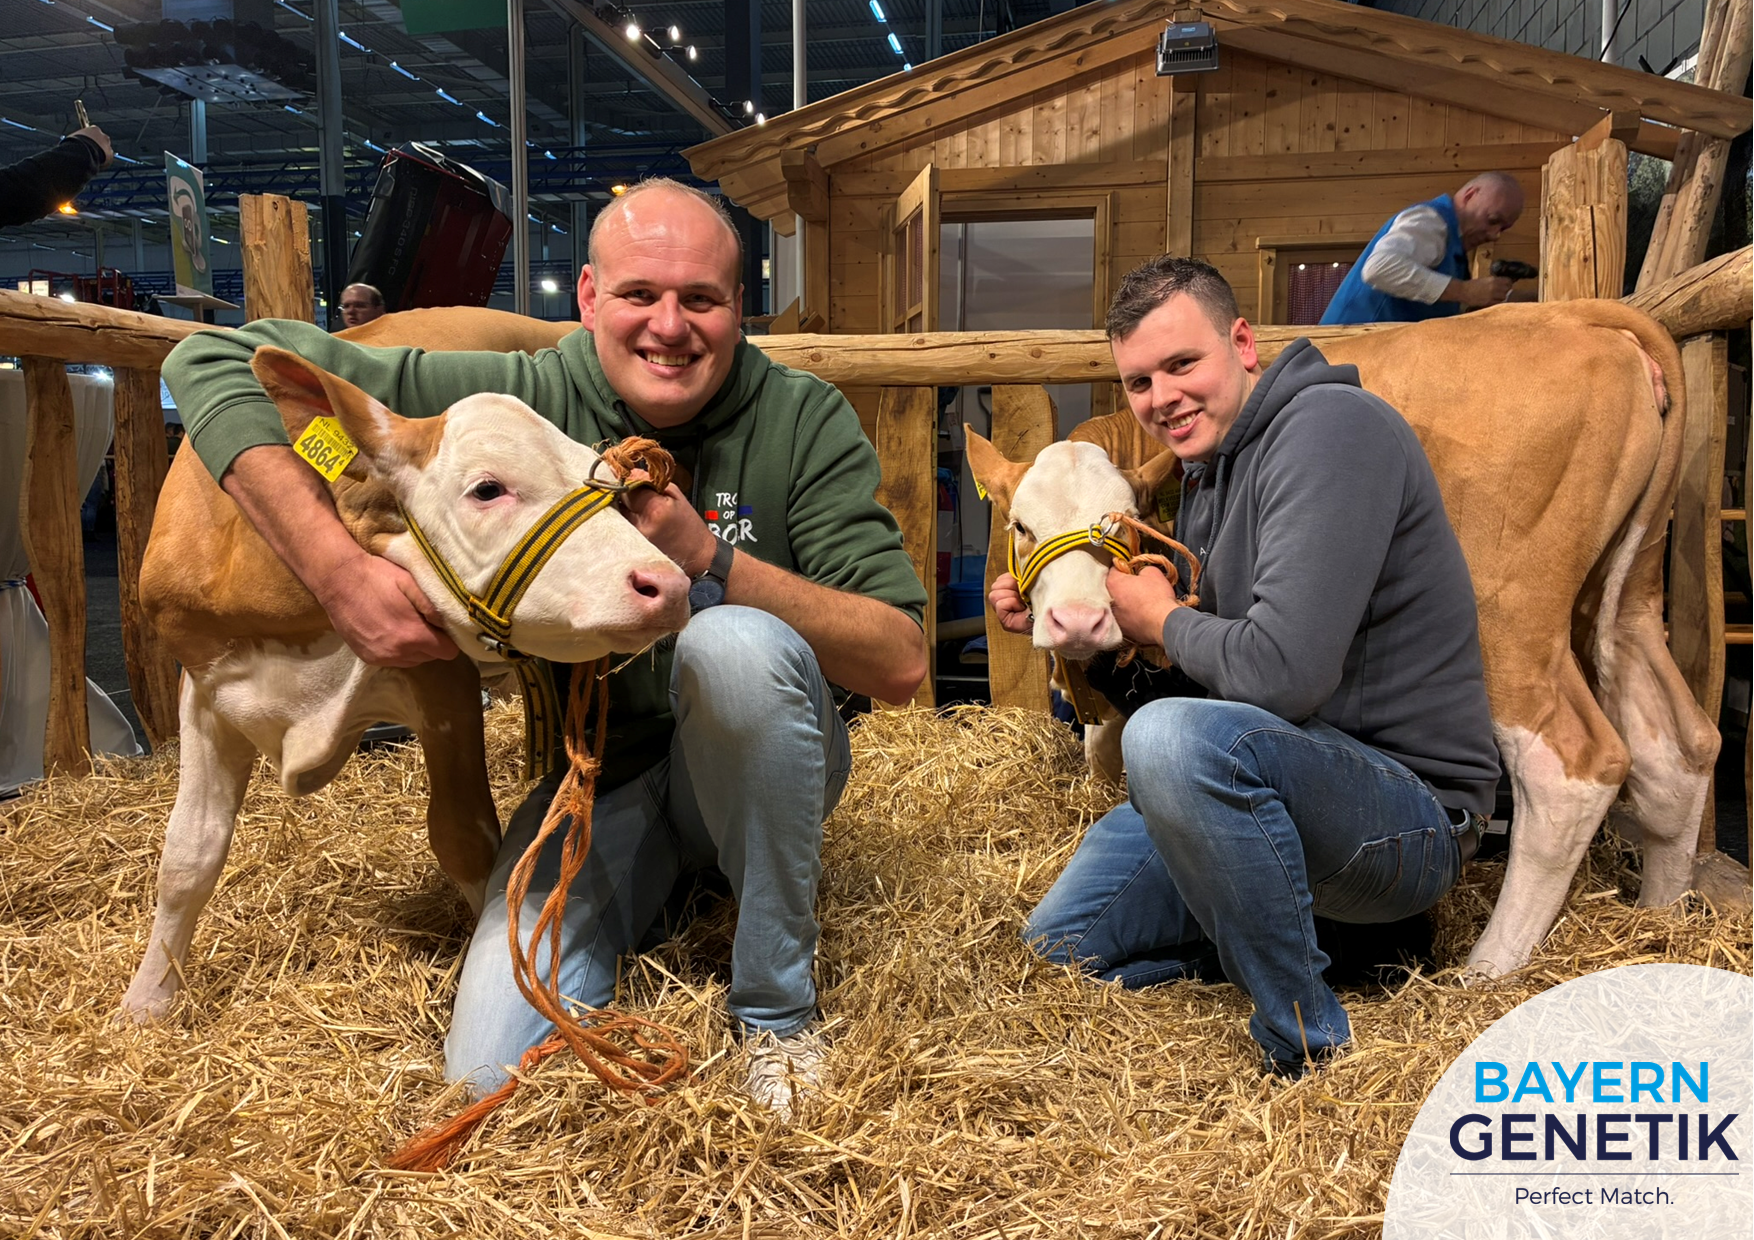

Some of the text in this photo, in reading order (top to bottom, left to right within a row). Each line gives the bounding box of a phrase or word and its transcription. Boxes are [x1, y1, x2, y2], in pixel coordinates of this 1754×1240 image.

[319, 418, 354, 450] NL 9432
[299, 433, 342, 474] 4864
[715, 492, 738, 508] TRO
[722, 510, 736, 520] OP
[707, 518, 758, 546] BOR
